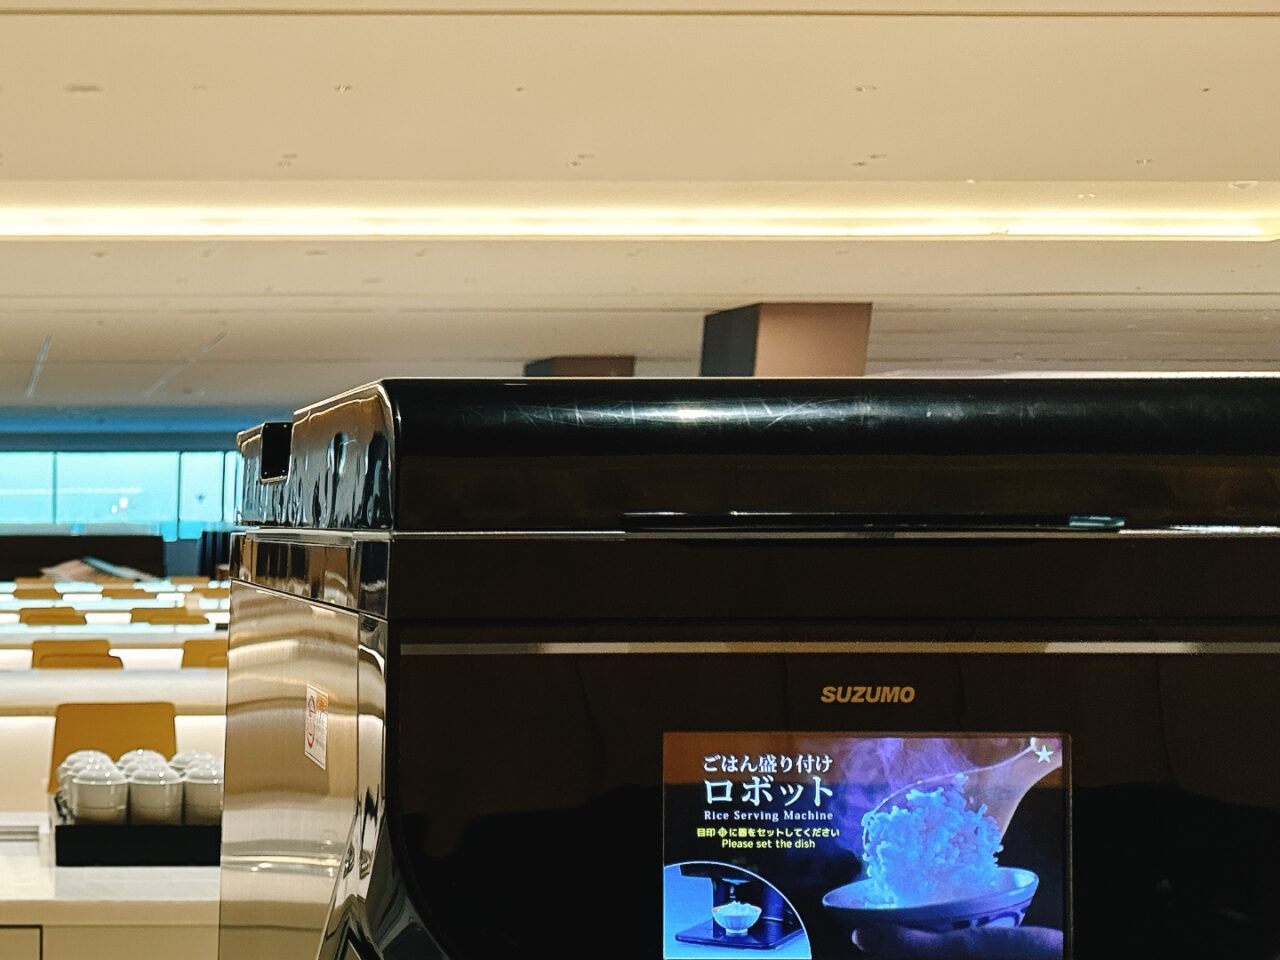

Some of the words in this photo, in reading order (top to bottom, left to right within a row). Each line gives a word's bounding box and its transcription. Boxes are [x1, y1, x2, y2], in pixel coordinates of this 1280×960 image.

[820, 686, 916, 703] SUZUMO
[703, 754, 833, 774] ごはん盛り付け
[704, 775, 833, 807] ロボット
[704, 811, 729, 820] Rice
[734, 811, 779, 822] Serving
[784, 811, 833, 820] Machine
[722, 839, 754, 848] Please
[756, 840, 772, 848] set
[775, 839, 792, 848] the
[795, 839, 815, 848] dish
